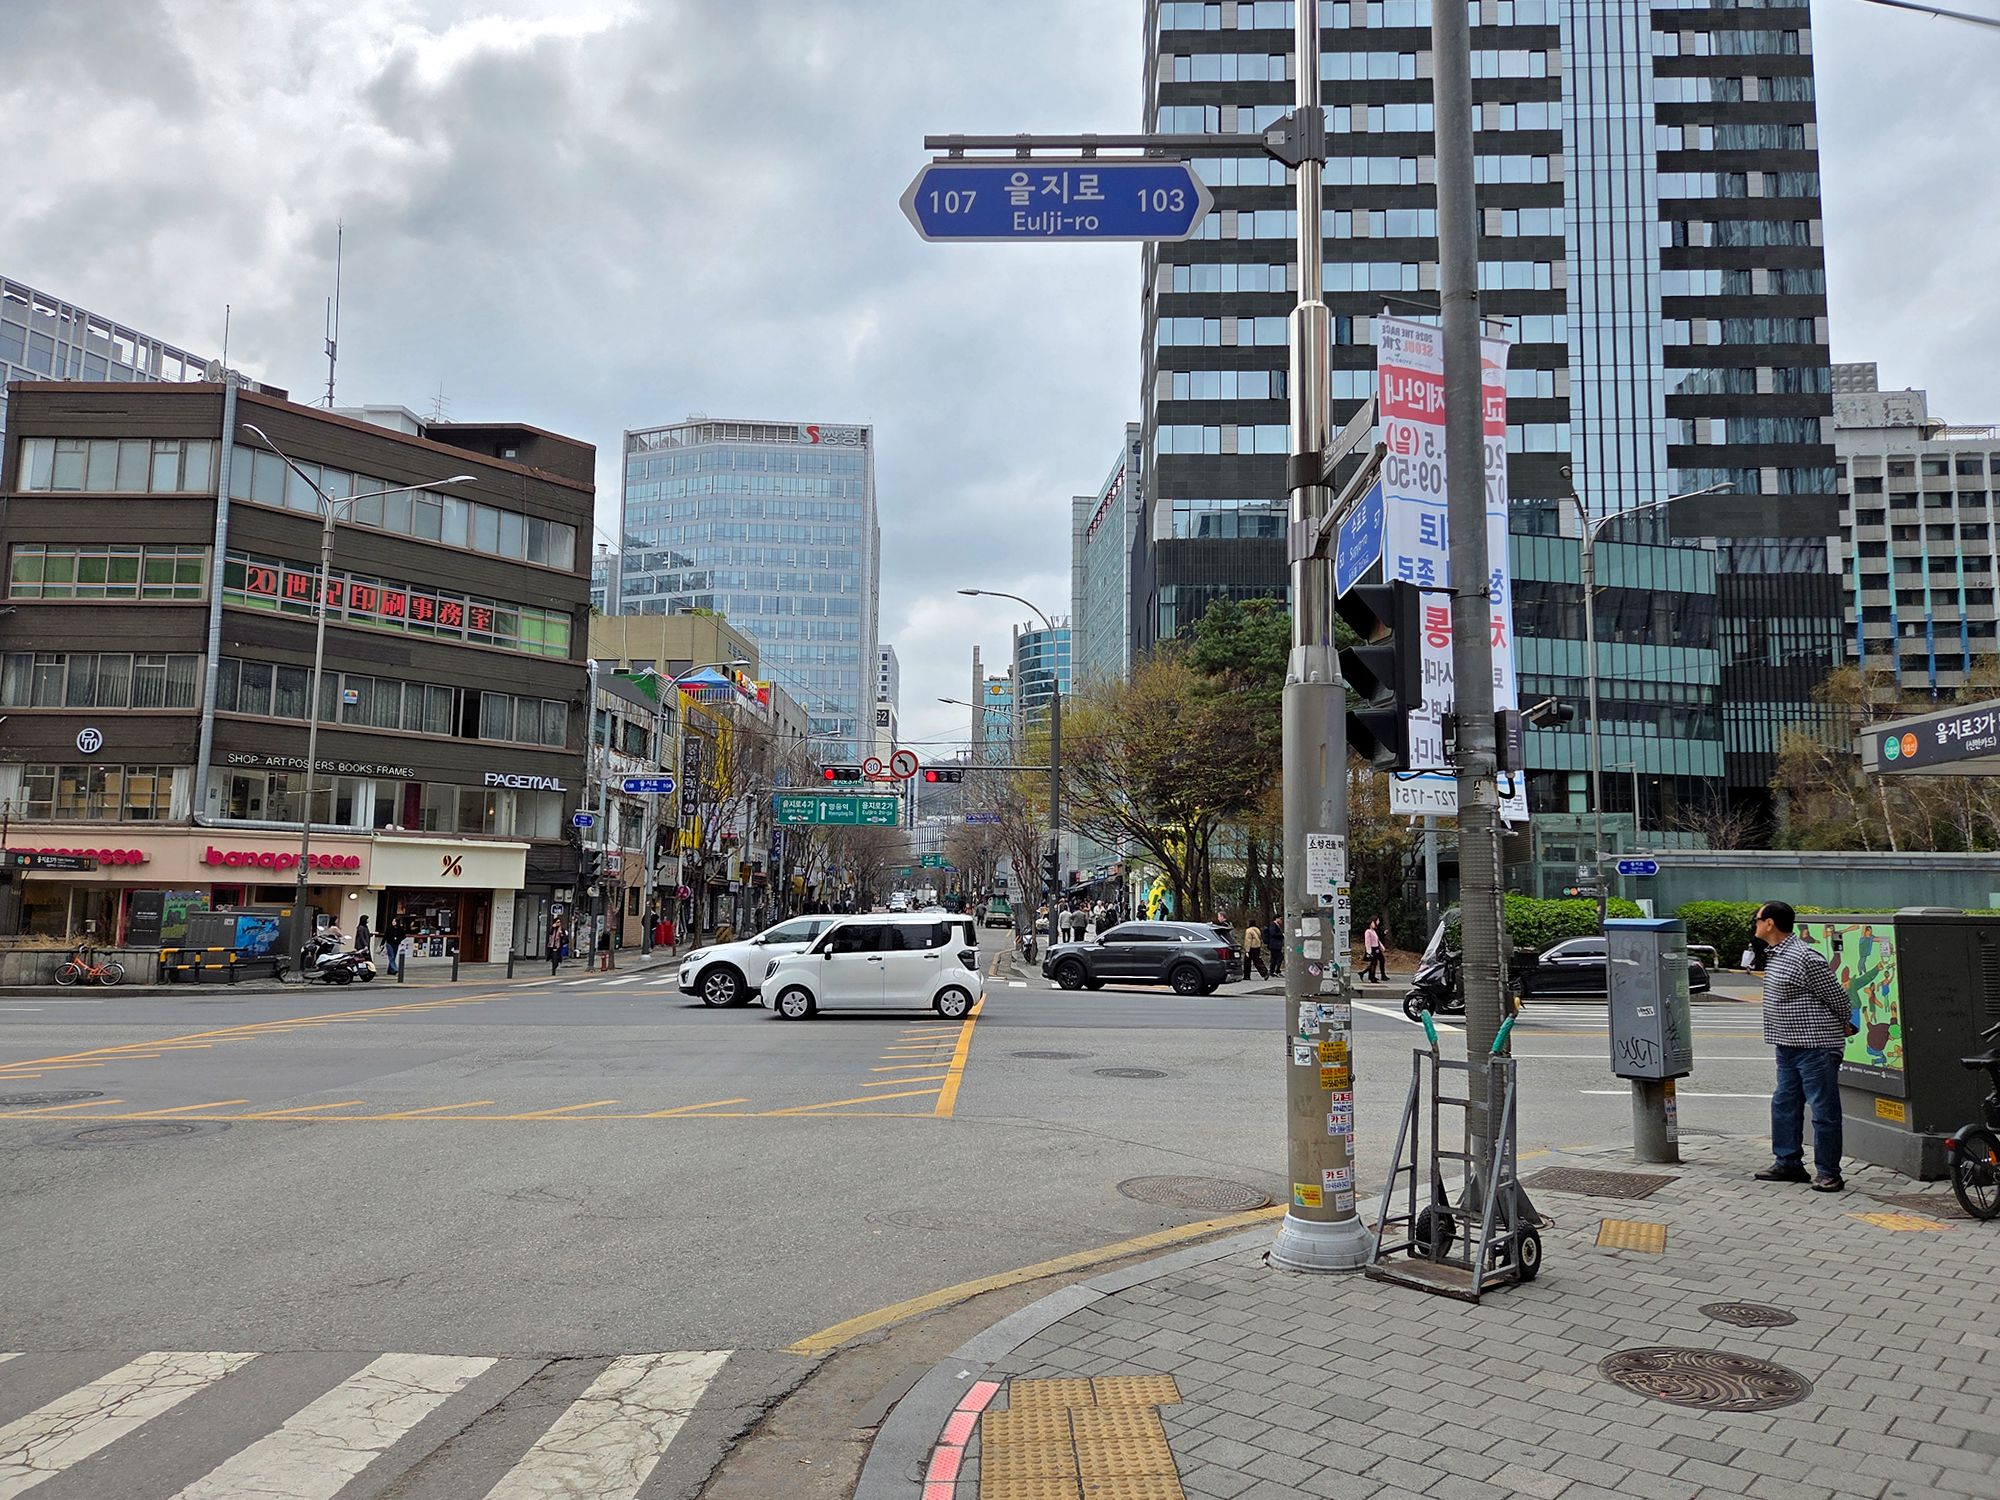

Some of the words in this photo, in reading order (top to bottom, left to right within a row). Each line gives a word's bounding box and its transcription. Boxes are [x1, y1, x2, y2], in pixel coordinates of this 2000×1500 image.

[1004, 171, 1105, 206] 을지로
[929, 190, 977, 214] 107
[1137, 189, 1184, 213] 103
[1013, 211, 1099, 234] Eulji-ro
[1351, 505, 1368, 540] 수표로
[1935, 712, 2000, 744] 을지로3가
[1965, 736, 1997, 752] (신한카드)
[288, 758, 335, 771] POSERS
[376, 765, 415, 777] FRAMES
[867, 763, 878, 771] 30
[484, 772, 567, 791] PAGEMAIL
[782, 800, 814, 808] 을지로4가
[862, 801, 893, 809] 을지로2가
